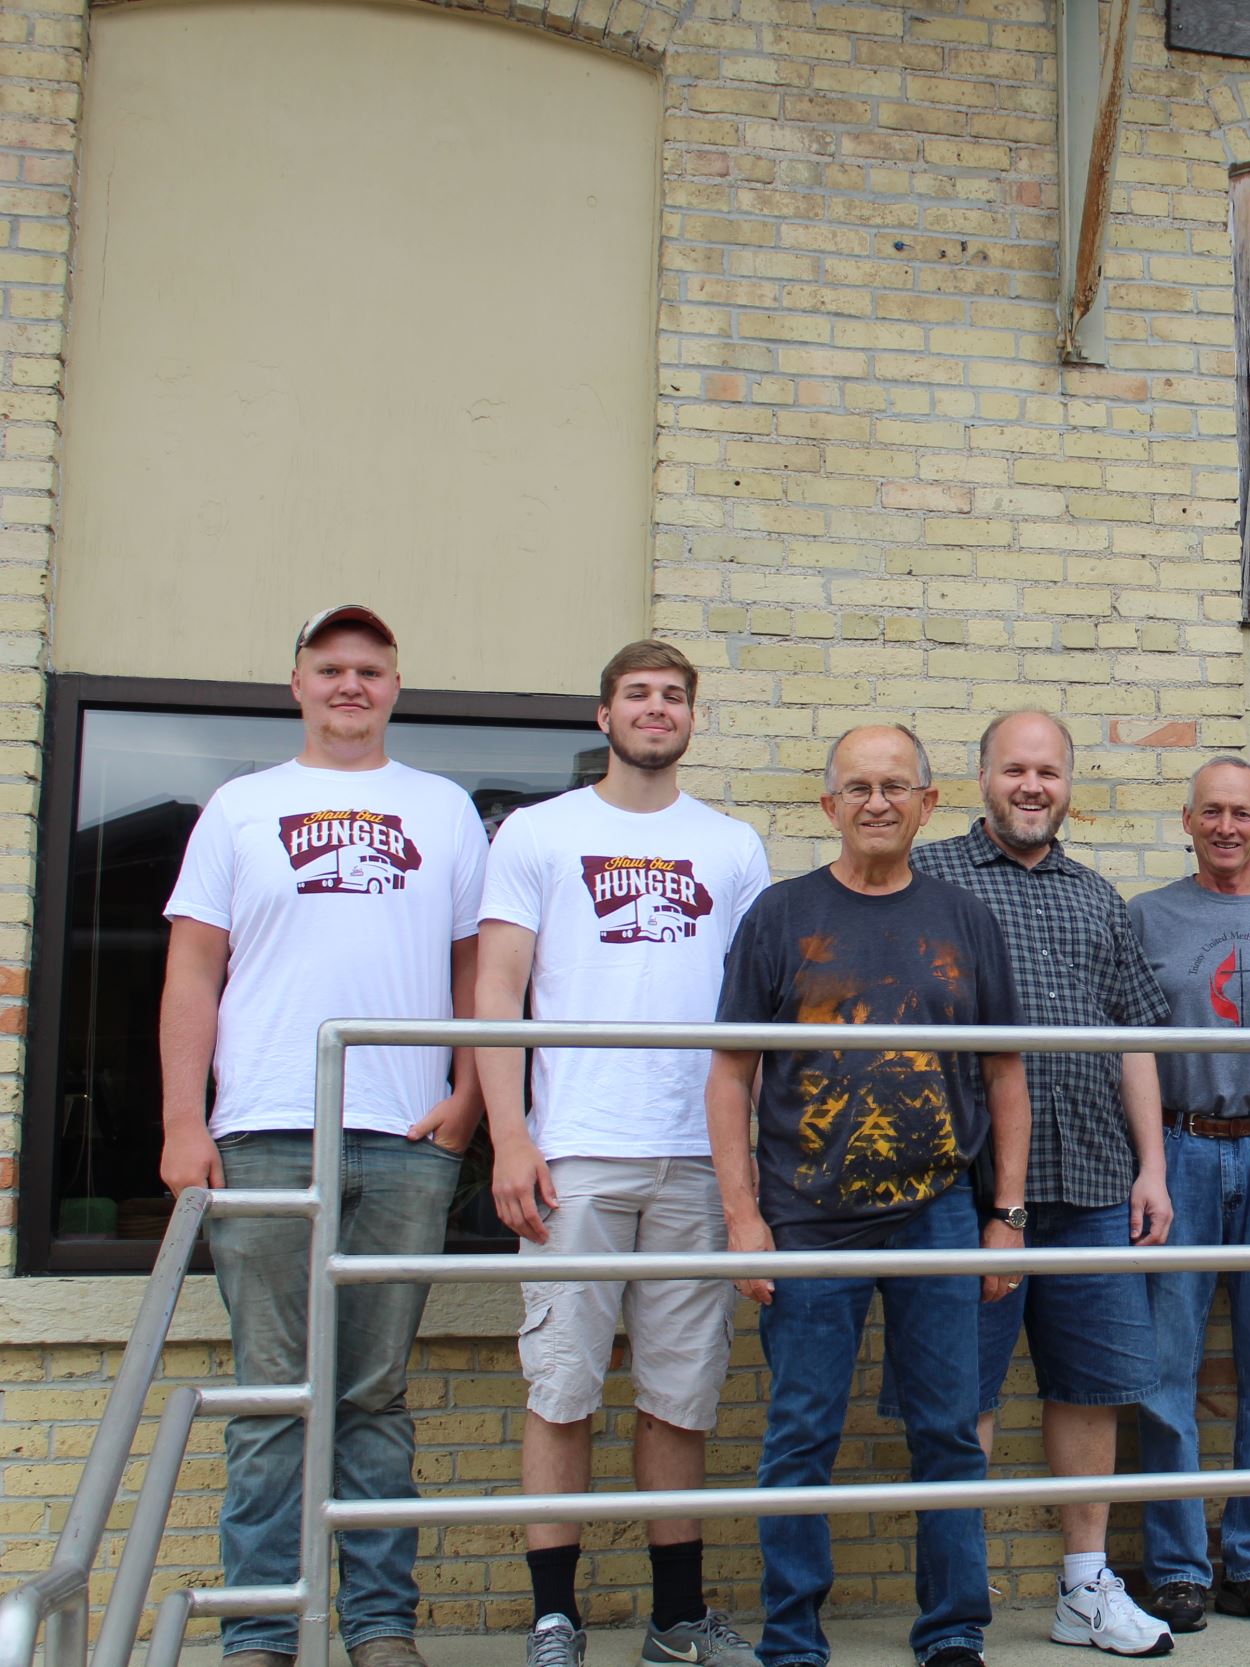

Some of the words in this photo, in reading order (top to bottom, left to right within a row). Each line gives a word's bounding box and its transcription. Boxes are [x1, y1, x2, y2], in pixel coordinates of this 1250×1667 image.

[304, 809, 353, 825] Haul
[356, 810, 384, 824] Out
[290, 820, 407, 860] HUNGER
[604, 855, 648, 870] Haul
[649, 857, 676, 871] Out
[594, 868, 697, 908] HUNGER
[1188, 953, 1205, 976] Trinity
[1202, 931, 1227, 952] United
